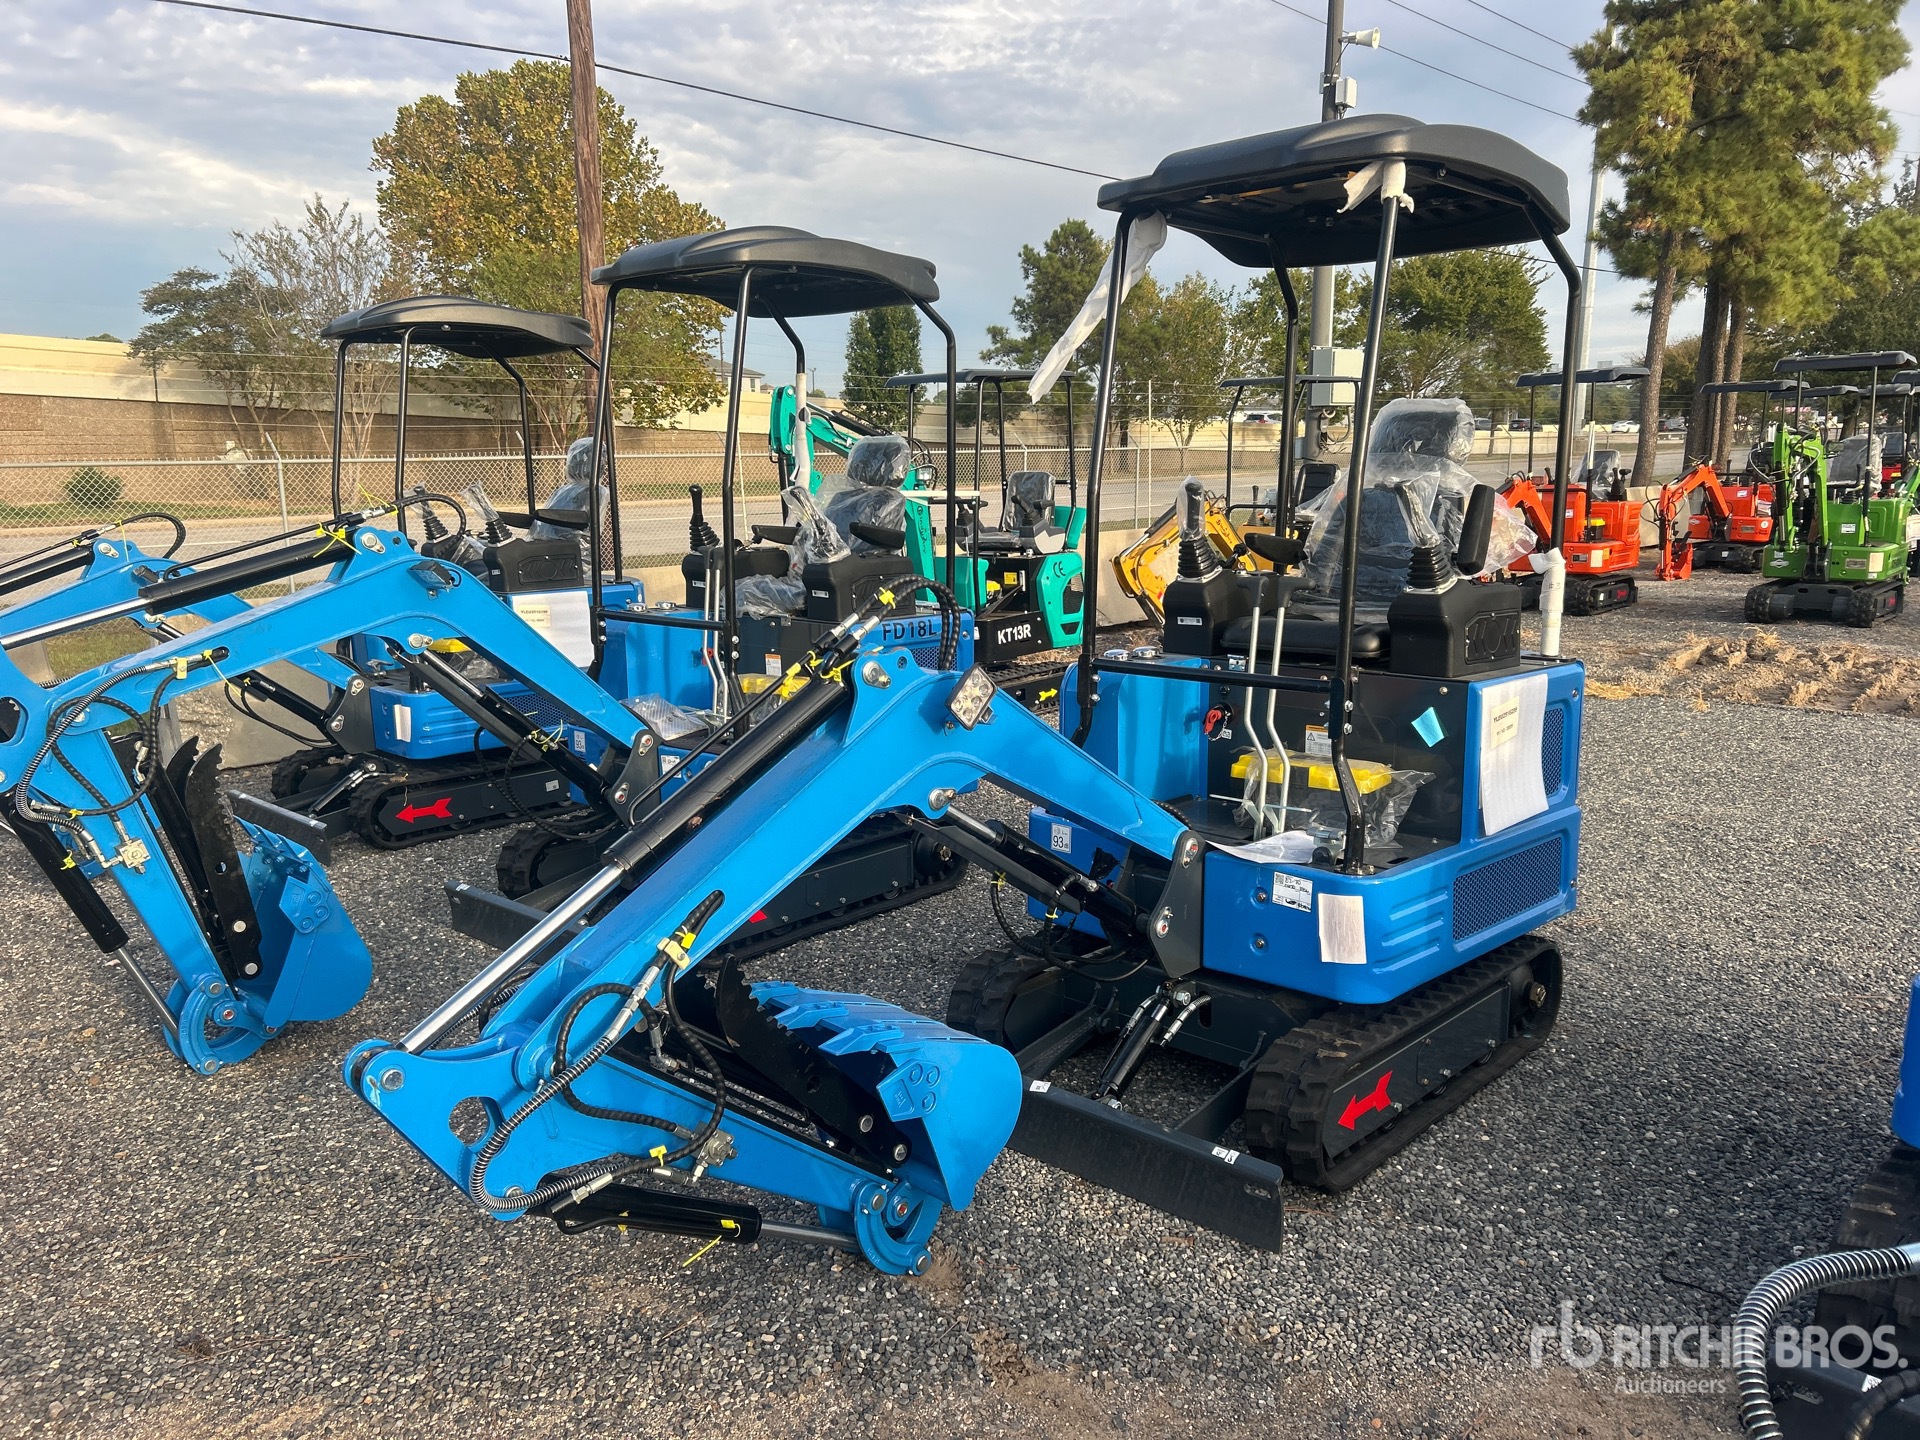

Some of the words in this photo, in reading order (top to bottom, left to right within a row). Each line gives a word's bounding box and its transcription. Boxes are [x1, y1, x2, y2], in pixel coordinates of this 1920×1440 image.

[882, 620, 937, 642] FD18L
[998, 624, 1032, 644] KT13R
[1053, 835, 1063, 848] 93
